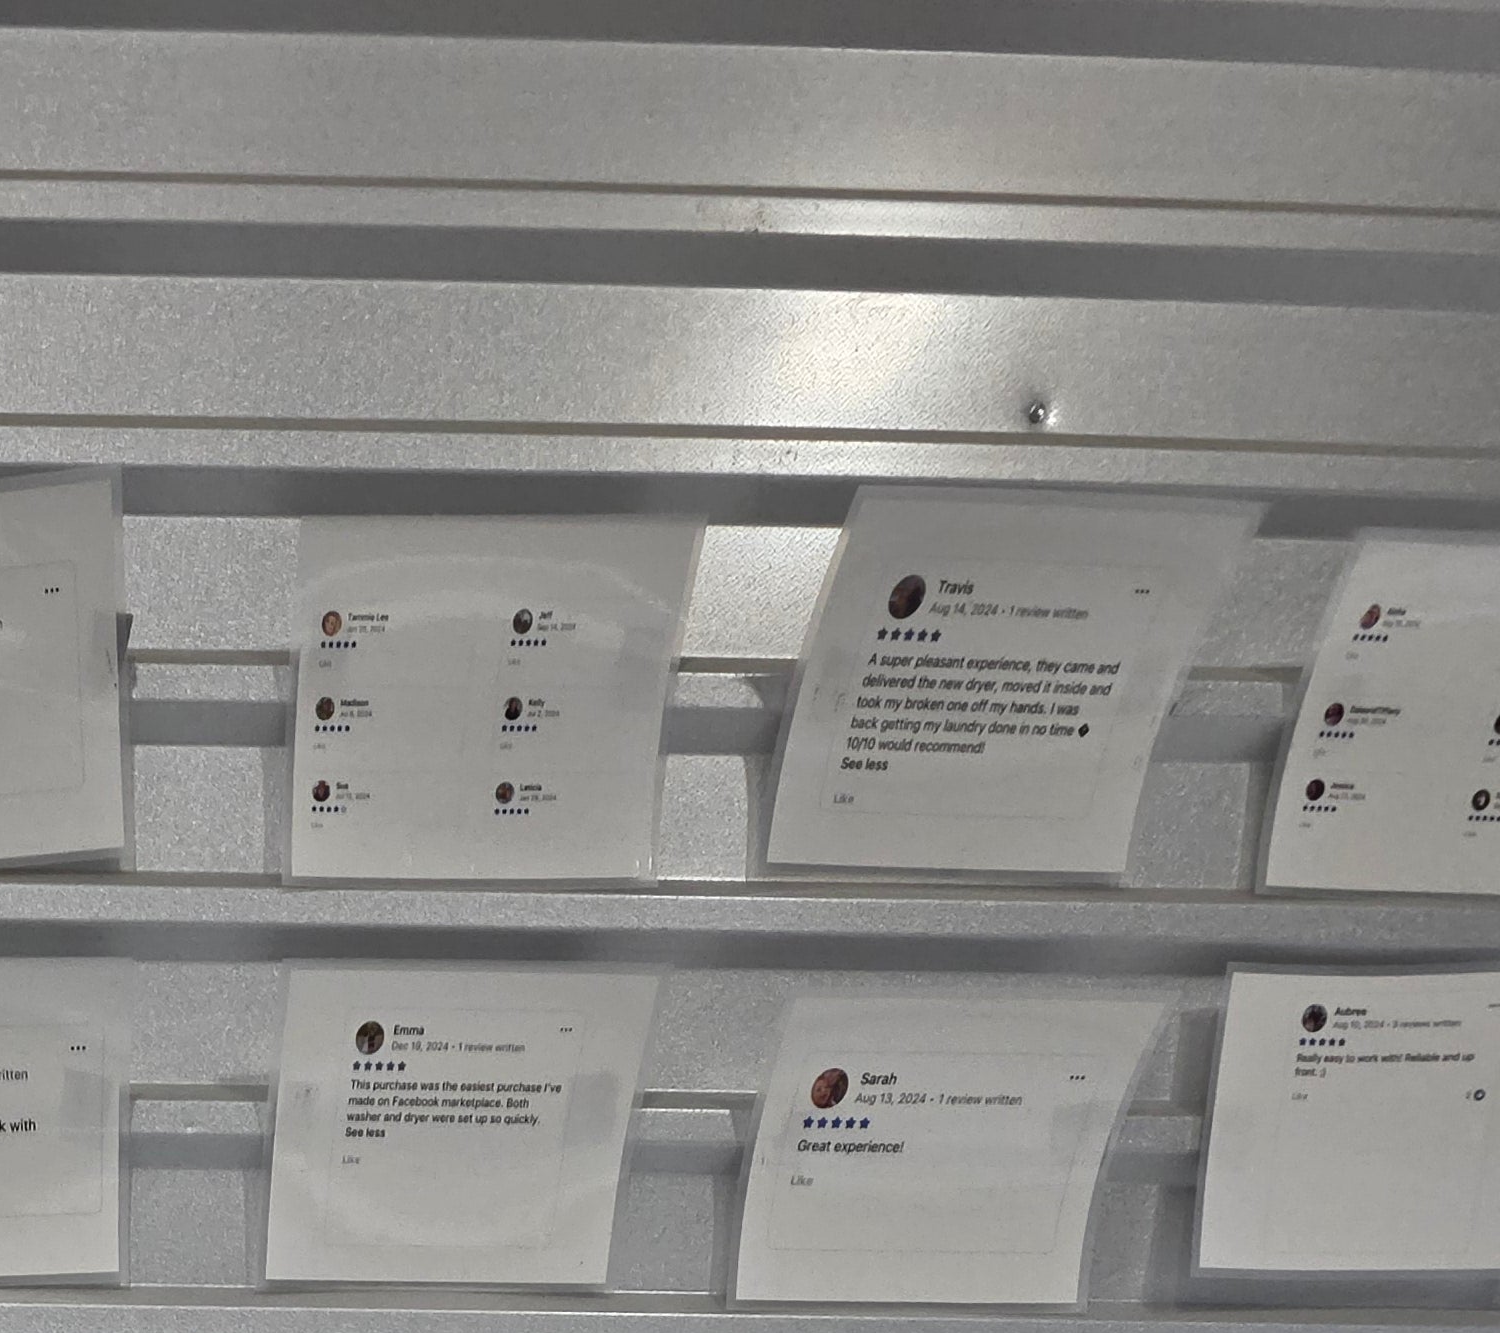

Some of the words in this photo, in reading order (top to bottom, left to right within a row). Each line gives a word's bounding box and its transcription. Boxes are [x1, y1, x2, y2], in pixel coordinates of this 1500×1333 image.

[860, 1072, 897, 1086] Sarah
[854, 1093, 877, 1106] Aug
[880, 1092, 894, 1106] 13,
[897, 1092, 927, 1104] 2024
[939, 1093, 944, 1104] 1
[945, 1093, 983, 1106] review
[985, 1094, 1022, 1105] written
[10, 1118, 36, 1133] with
[797, 1139, 831, 1152] Great
[833, 1140, 905, 1155] experience!
